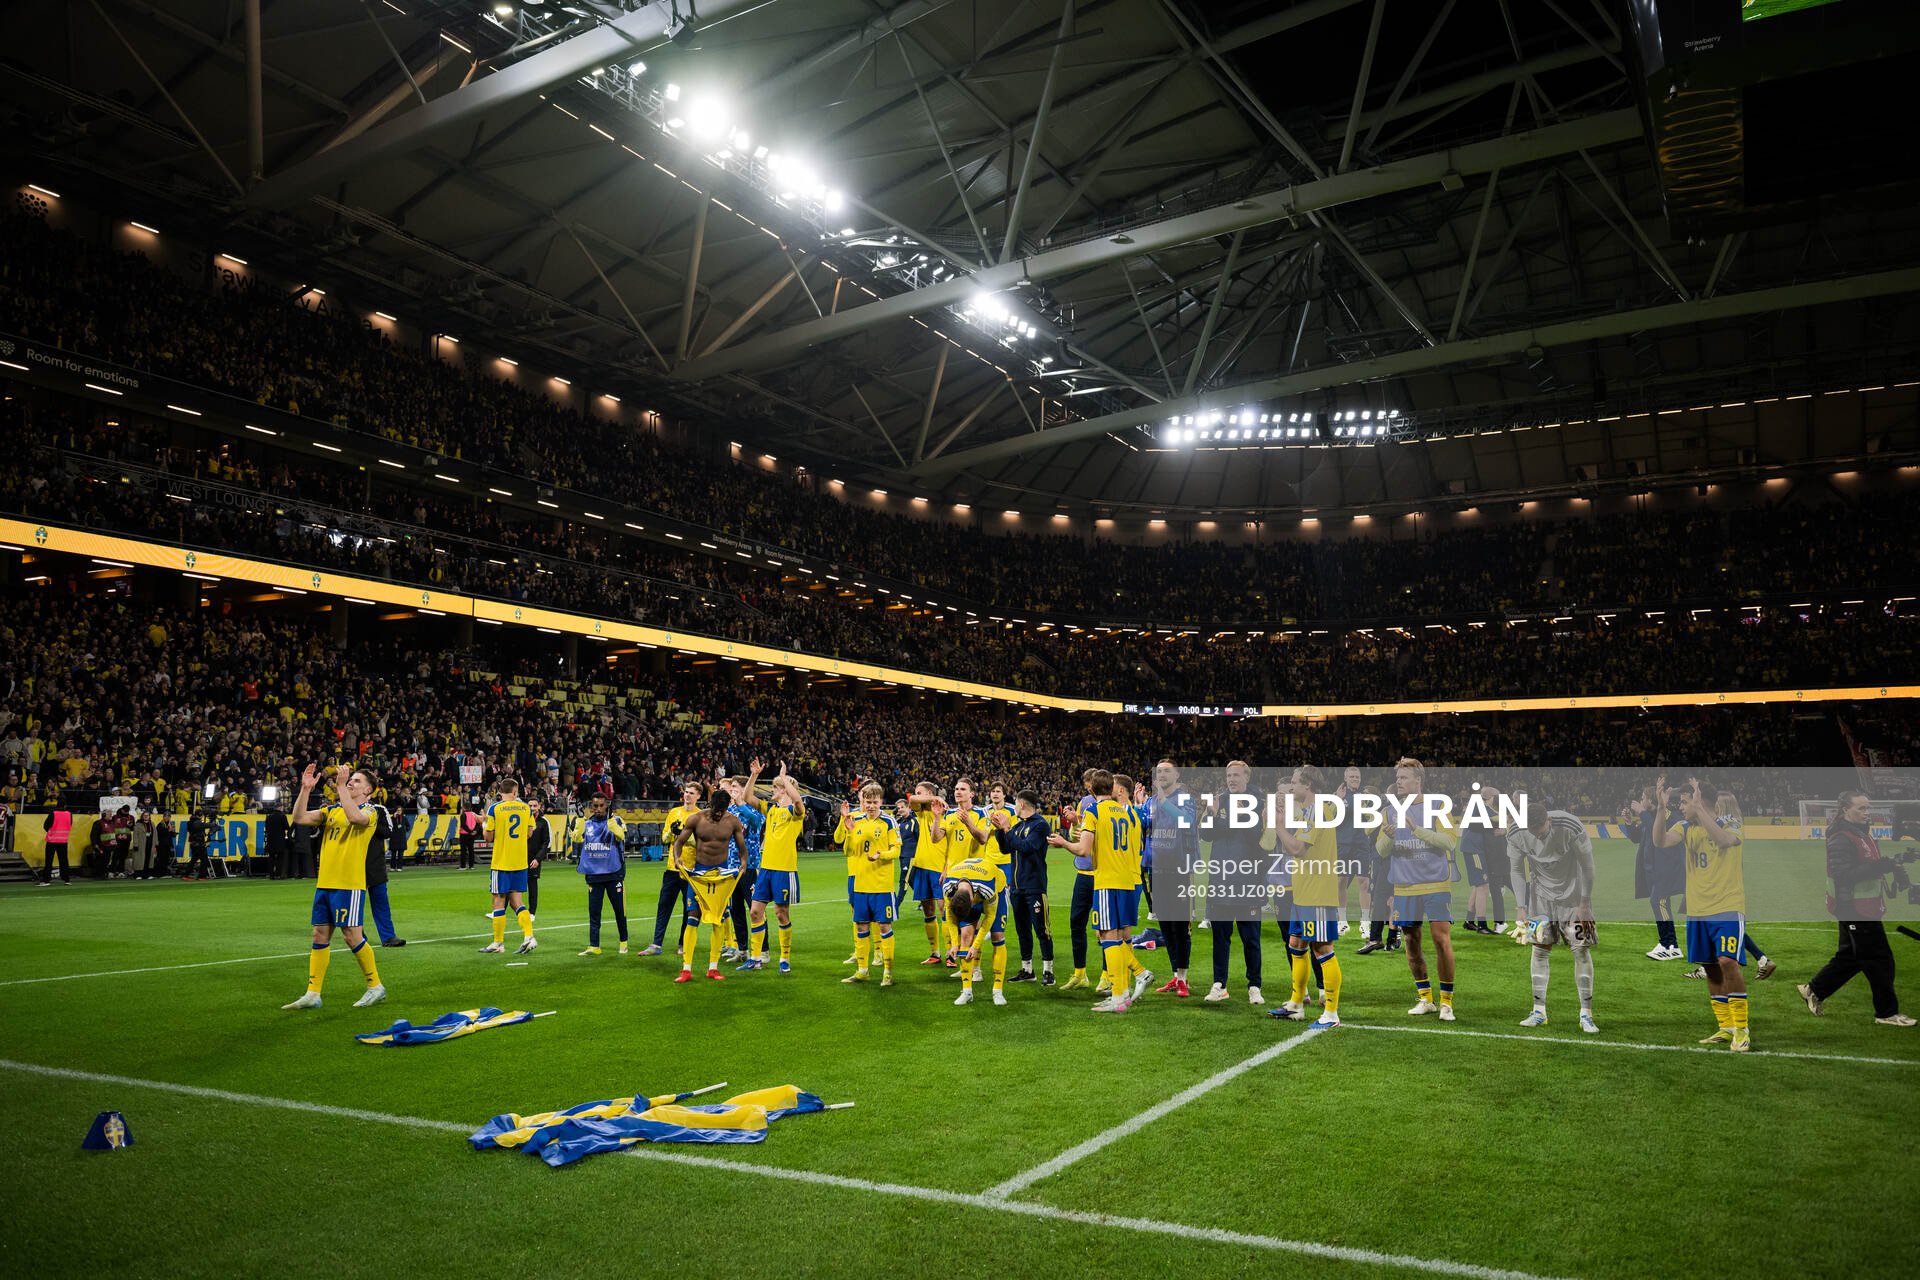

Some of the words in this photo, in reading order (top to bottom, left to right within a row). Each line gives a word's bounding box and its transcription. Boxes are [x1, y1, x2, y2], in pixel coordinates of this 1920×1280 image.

[1684, 36, 1720, 48] Strawberry
[27, 347, 63, 367] Room
[65, 360, 83, 373] for
[84, 367, 139, 388] emotions
[167, 480, 209, 500] WEST
[1178, 706, 1199, 714] 90:00
[509, 814, 520, 839] 2
[772, 822, 778, 832] 7
[329, 827, 341, 841] 17
[955, 829, 966, 841] 15
[1110, 817, 1129, 851] 10
[864, 840, 870, 852] 8
[1694, 852, 1708, 869] 18
[707, 882, 716, 895] 11
[782, 889, 789, 901] 7
[335, 908, 348, 923] 17
[886, 906, 893, 919] 8
[1303, 921, 1315, 937] 19
[1720, 935, 1737, 953] 18
